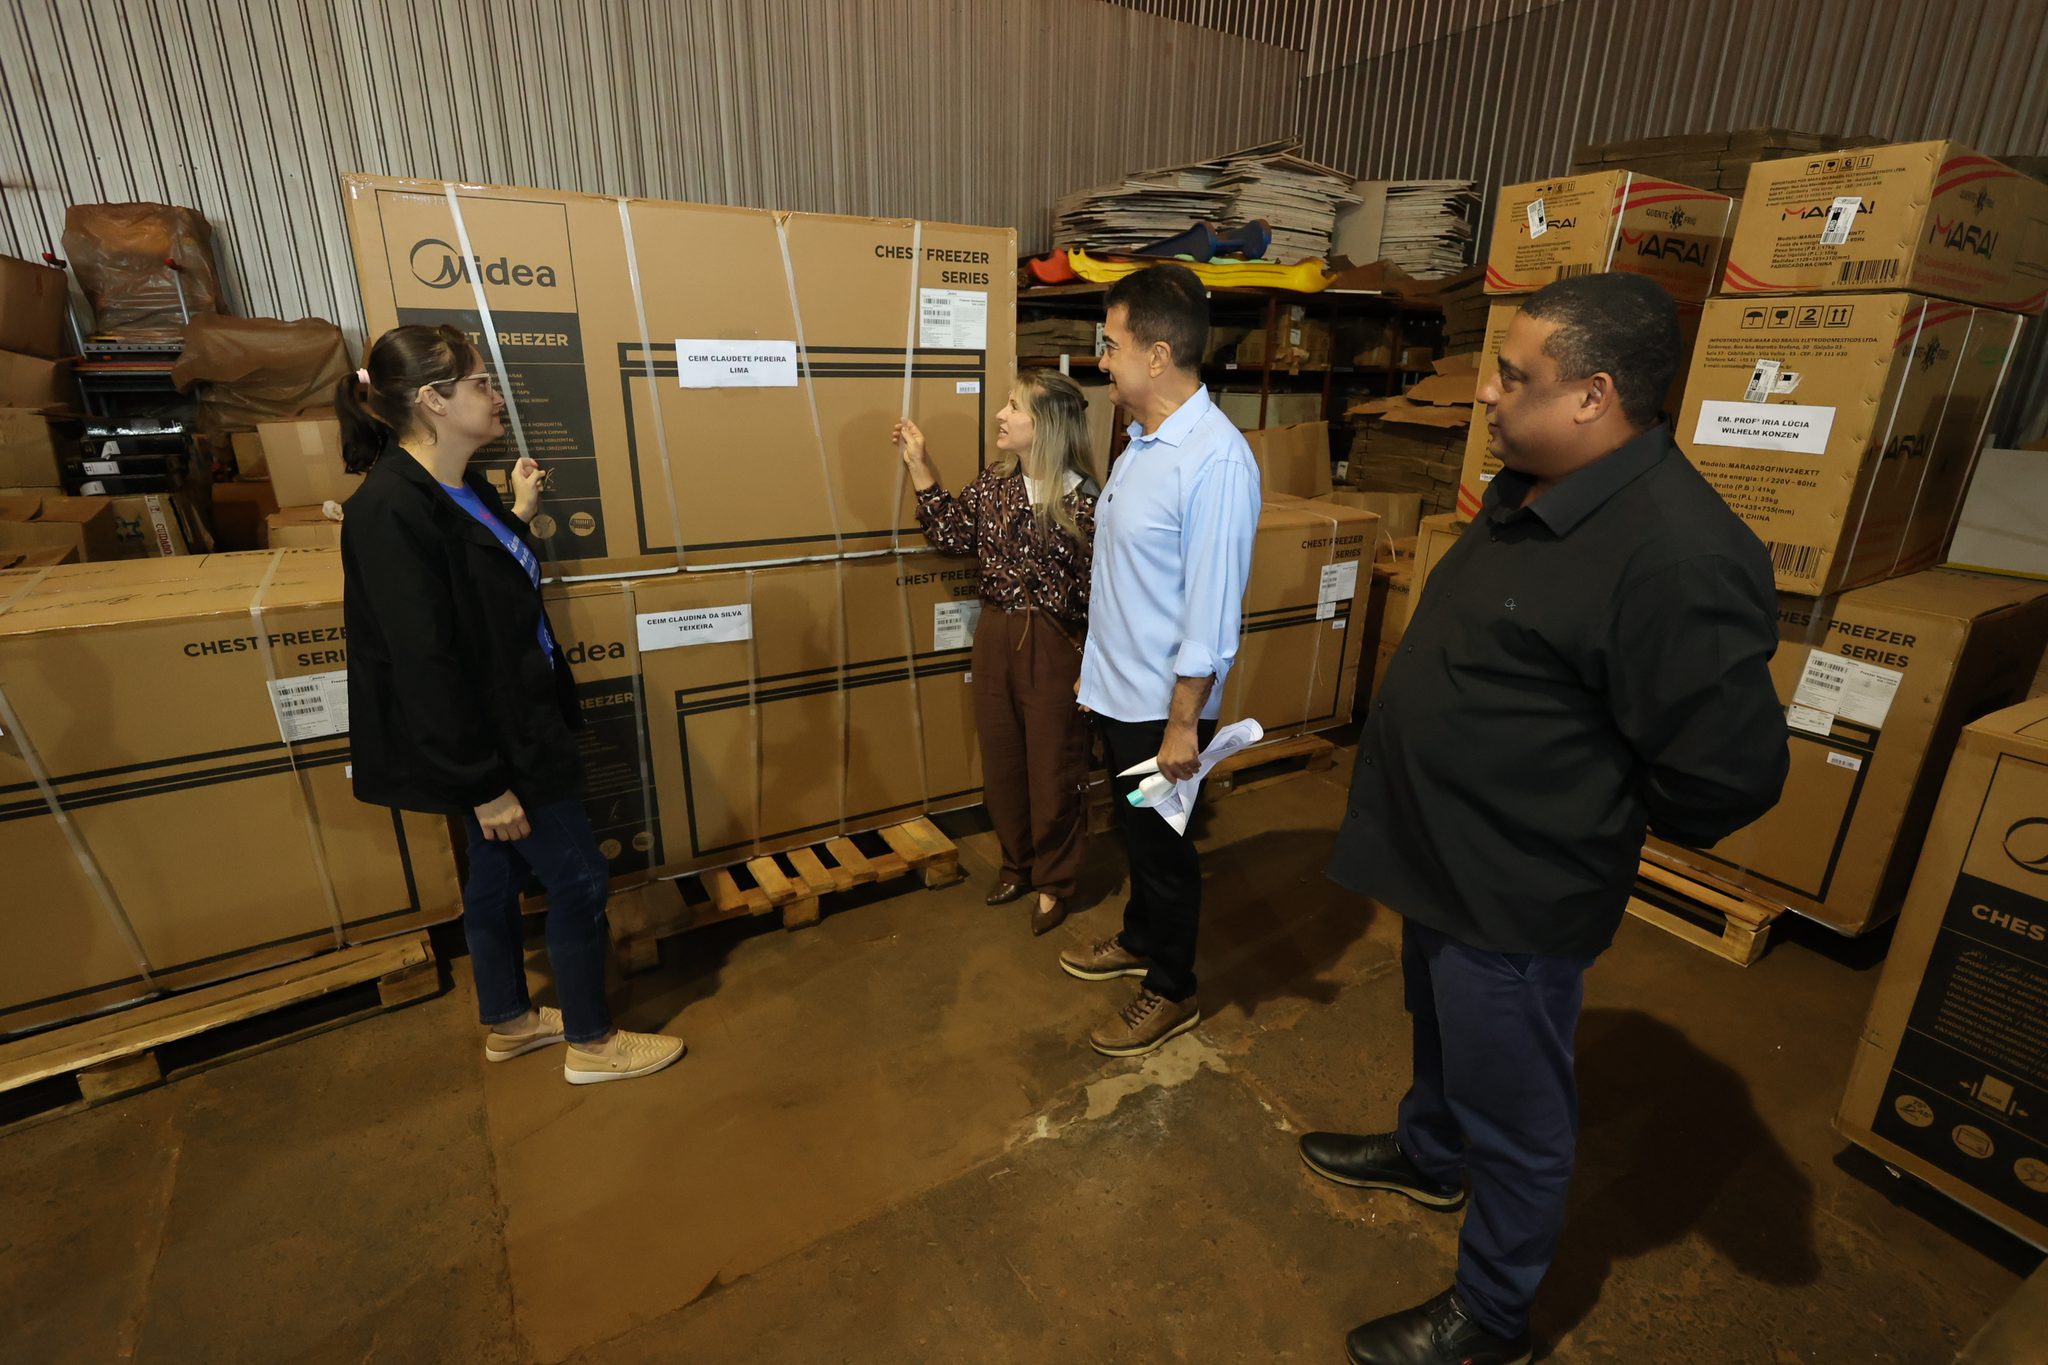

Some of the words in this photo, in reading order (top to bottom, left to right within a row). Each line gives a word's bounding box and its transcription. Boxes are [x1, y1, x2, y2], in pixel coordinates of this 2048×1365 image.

[874, 244, 923, 260] CHES
[927, 248, 990, 265] FREEZER
[941, 270, 990, 286] SERIES
[1804, 308, 1817, 321] 2
[499, 332, 569, 347] REEZER
[688, 355, 709, 363] CEIM
[710, 355, 752, 363] CLAUDETE
[1721, 427, 1760, 436] WILHELM
[1762, 430, 1800, 439] KONZEN
[1301, 538, 1329, 549] CHEST
[1335, 548, 1362, 559] SERIES
[896, 573, 937, 586] CHEST
[668, 614, 707, 624] CLAUDINA
[721, 610, 742, 618] SILVA
[678, 623, 714, 632] TEIXEIRA
[1778, 610, 1823, 627] HES
[1827, 619, 1917, 648] FREEZER
[183, 635, 259, 658] CHEST
[266, 625, 348, 648] FREEZE
[297, 649, 346, 667] SERI
[566, 641, 625, 665] dea
[1840, 643, 1909, 668] SERIES
